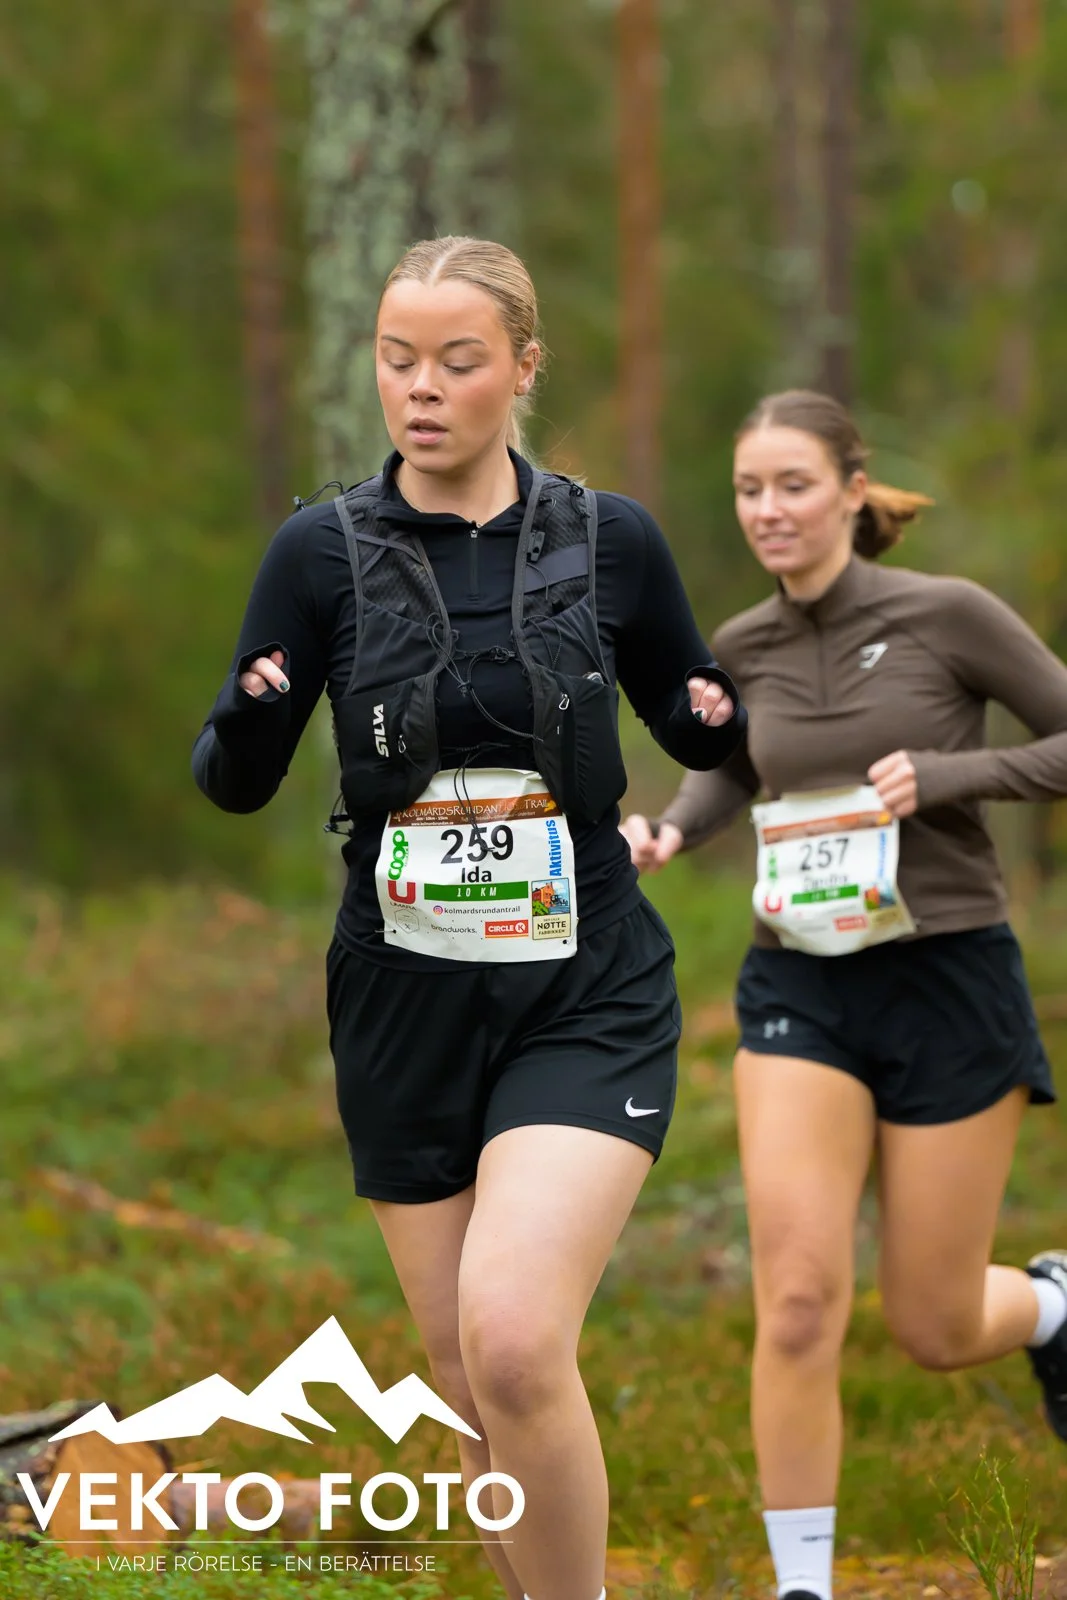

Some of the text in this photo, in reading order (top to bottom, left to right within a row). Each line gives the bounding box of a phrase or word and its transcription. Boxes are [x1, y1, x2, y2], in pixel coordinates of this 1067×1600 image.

[373, 704, 389, 757] SILVA
[524, 799, 548, 809] TRAIL
[440, 825, 514, 864] 259
[546, 820, 562, 876] Aktivitus
[388, 830, 409, 880] coop
[800, 838, 849, 871] 257
[461, 866, 492, 883] Ida
[457, 887, 497, 897] 10 KM
[444, 906, 521, 914] kolmardsrundantrail
[488, 923, 525, 932] CIRCLE K
[537, 920, 566, 930] NØTTE
